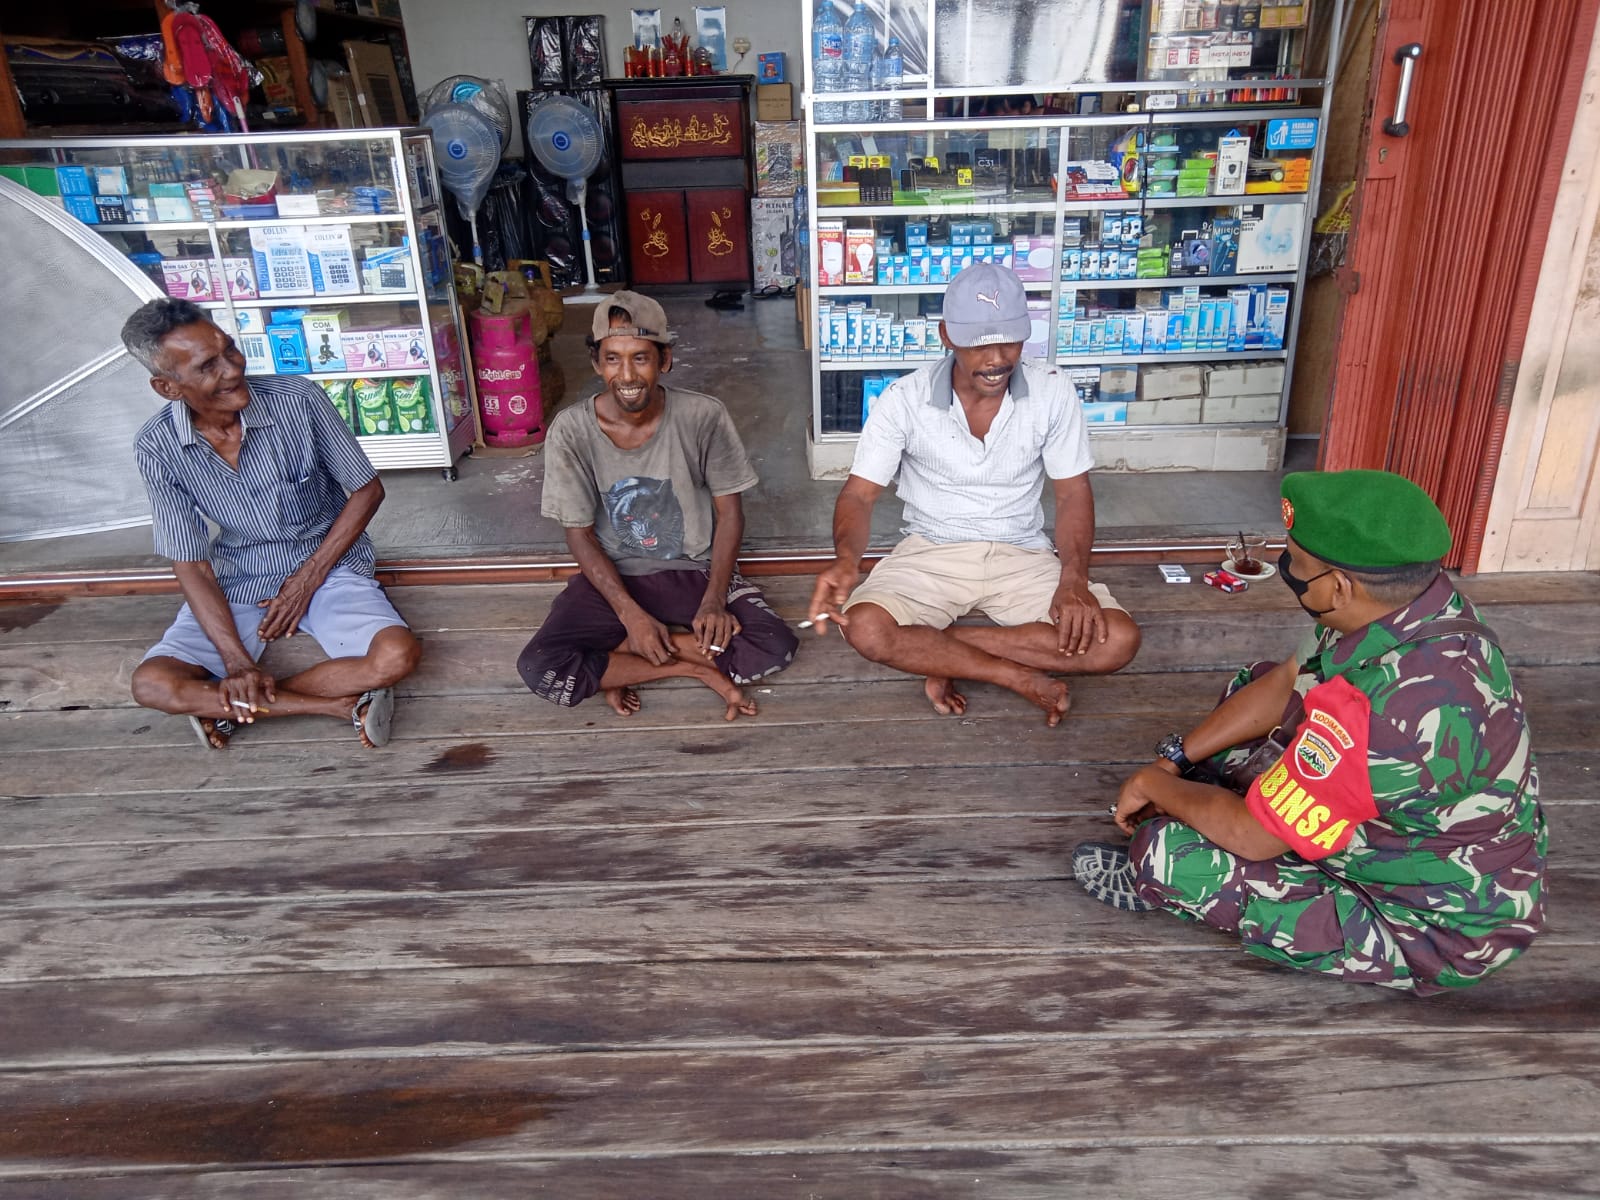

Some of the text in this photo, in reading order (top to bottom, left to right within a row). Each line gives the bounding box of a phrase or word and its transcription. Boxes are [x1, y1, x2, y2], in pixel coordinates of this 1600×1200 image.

[978, 159, 994, 167] C31
[564, 675, 577, 691] CITY
[1259, 760, 1350, 851] BINSA
